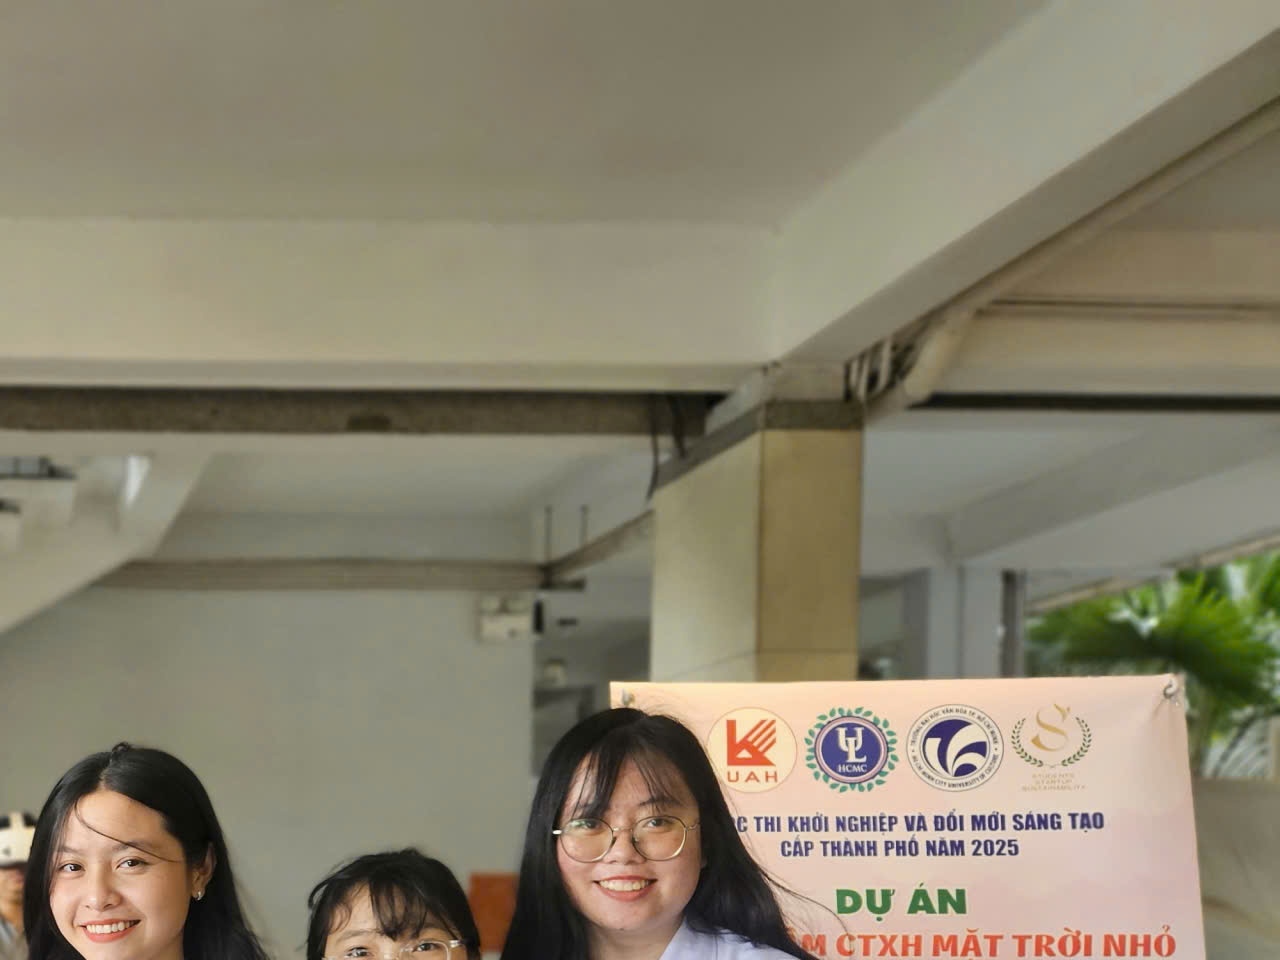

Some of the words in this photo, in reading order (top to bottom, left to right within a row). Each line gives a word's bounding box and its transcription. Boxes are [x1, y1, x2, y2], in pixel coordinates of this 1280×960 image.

[727, 771, 778, 783] UAH
[837, 763, 867, 773] HCMC
[753, 816, 781, 833] THI
[788, 812, 829, 833] KHỞI
[836, 812, 898, 835] NGHIỆP
[904, 811, 928, 832] VÀ
[933, 808, 965, 832] ĐỔI
[971, 811, 1006, 832] MỚI
[1012, 811, 1062, 831] SÁNG
[1068, 812, 1105, 833] TẠO
[780, 835, 814, 857] CẤP
[820, 836, 878, 857] THÀNH
[884, 834, 919, 857] PHỐ
[926, 834, 965, 857] NĂM
[971, 839, 1019, 856] 2025
[836, 888, 896, 922] DỰ
[907, 882, 967, 915] ÁN
[836, 934, 922, 957] CTXH
[1012, 927, 1093, 958] TRỜI
[1103, 924, 1176, 958] NHỎ
